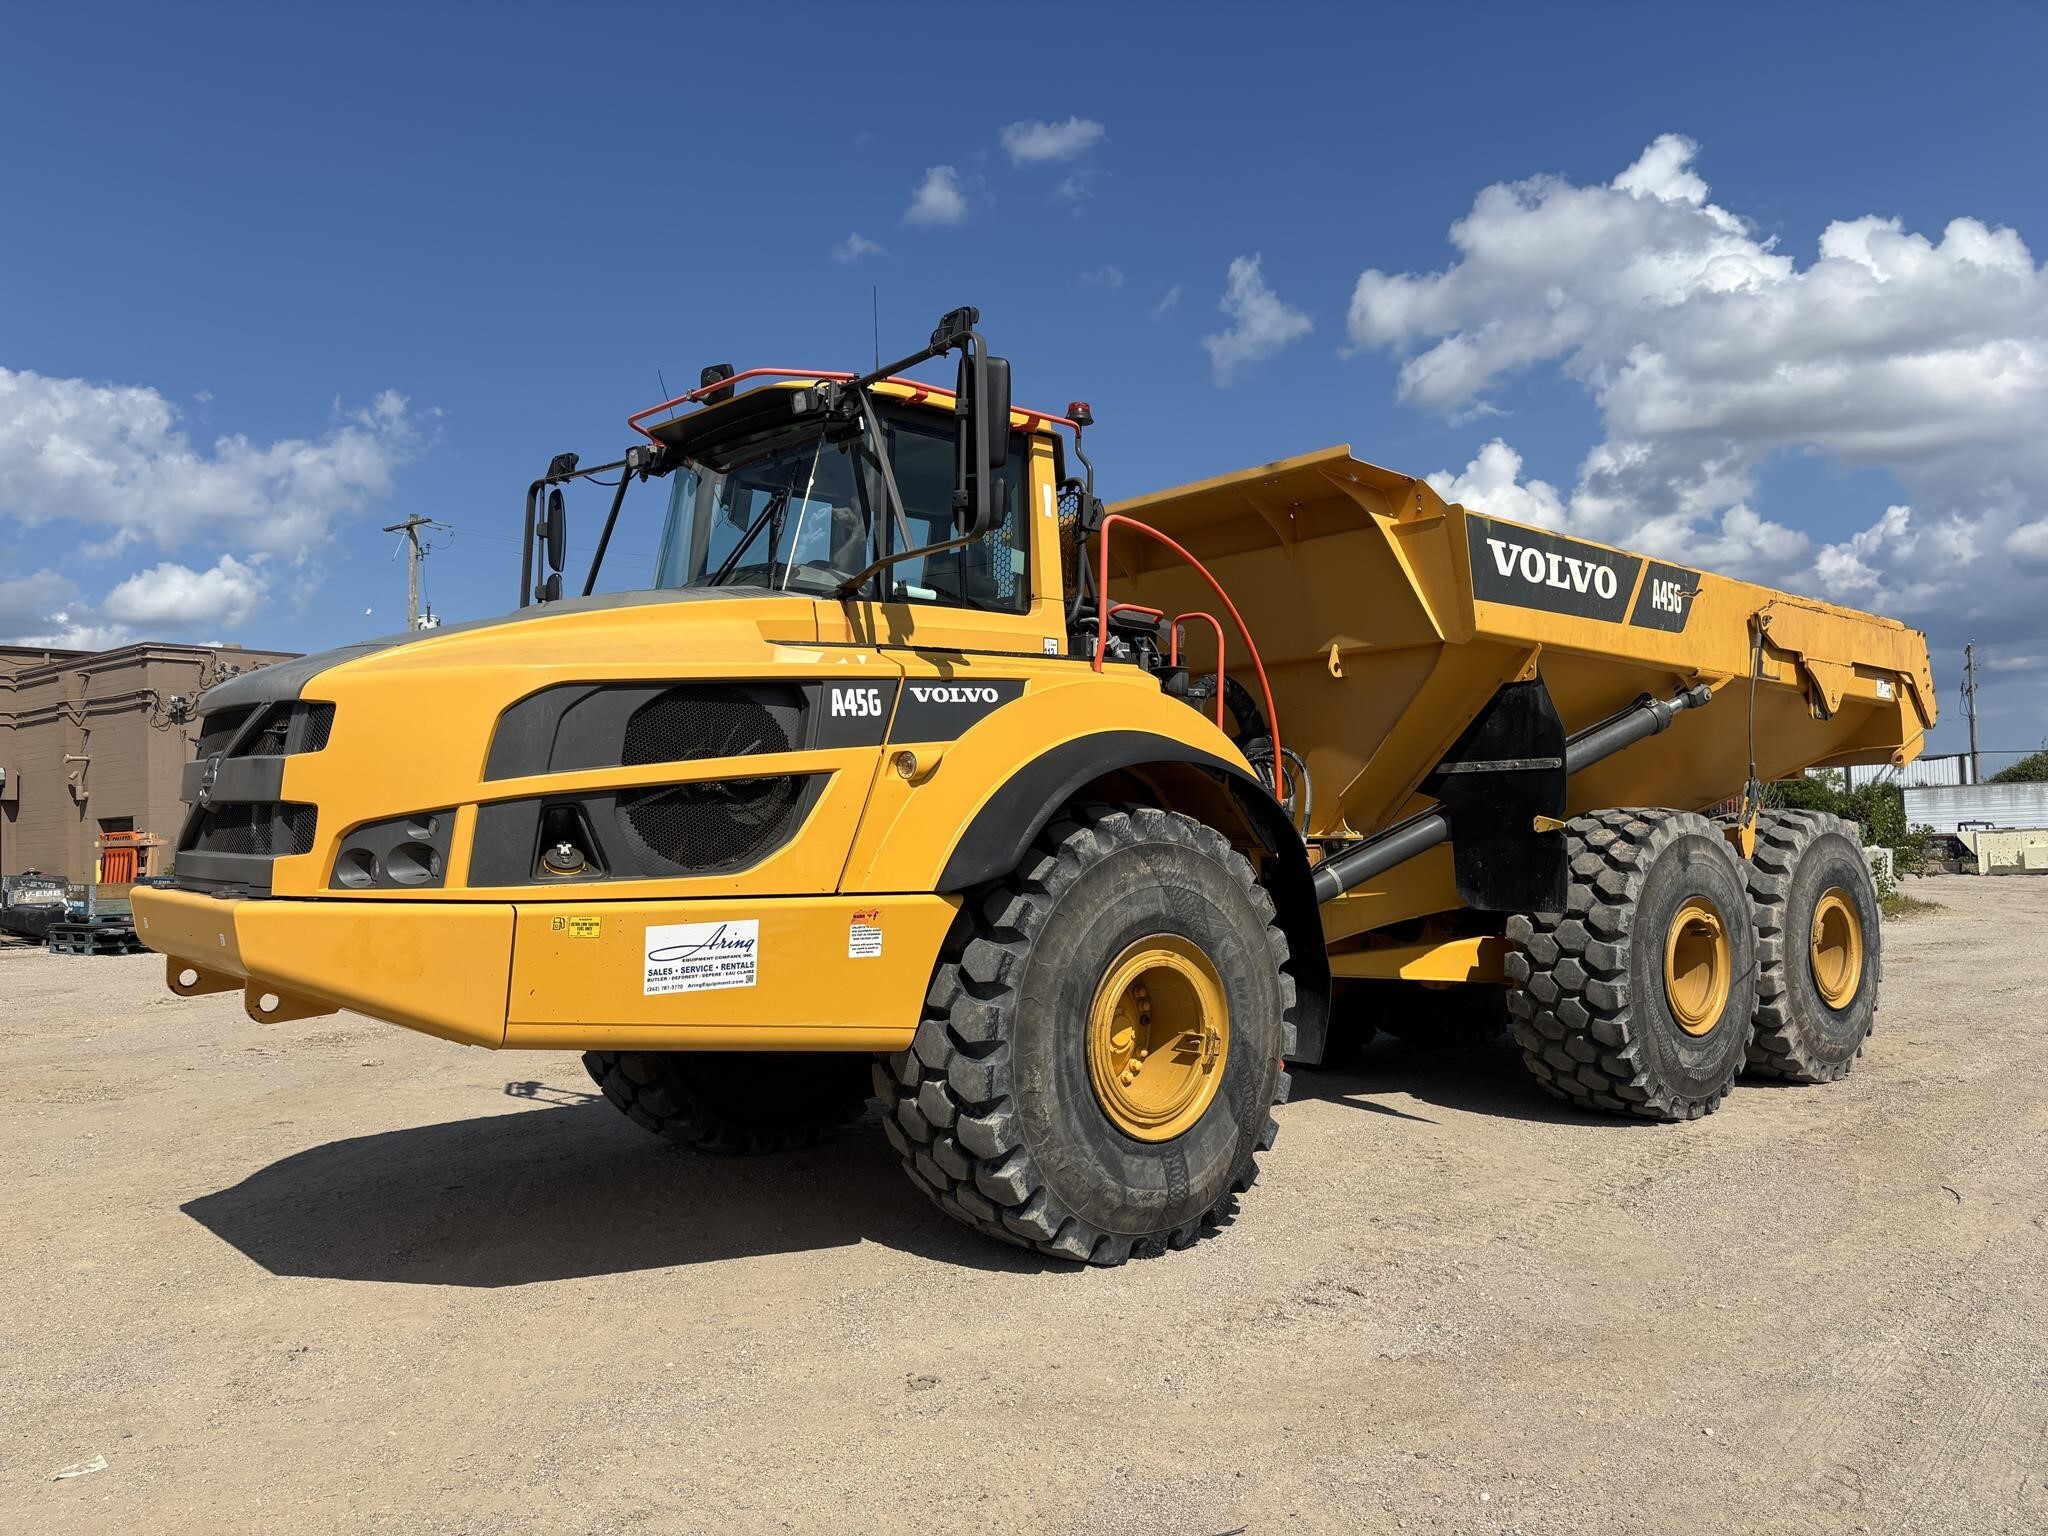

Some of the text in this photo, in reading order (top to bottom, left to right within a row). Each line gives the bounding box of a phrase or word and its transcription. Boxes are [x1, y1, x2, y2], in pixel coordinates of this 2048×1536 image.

[1486, 538, 1618, 600] VOLVO
[1652, 578, 1682, 614] A45G
[831, 688, 882, 717] A45G
[909, 687, 999, 703] VOLVO
[648, 961, 755, 977] SALES SERVICE RENTALS
[687, 979, 744, 989] AringEquipment.com
